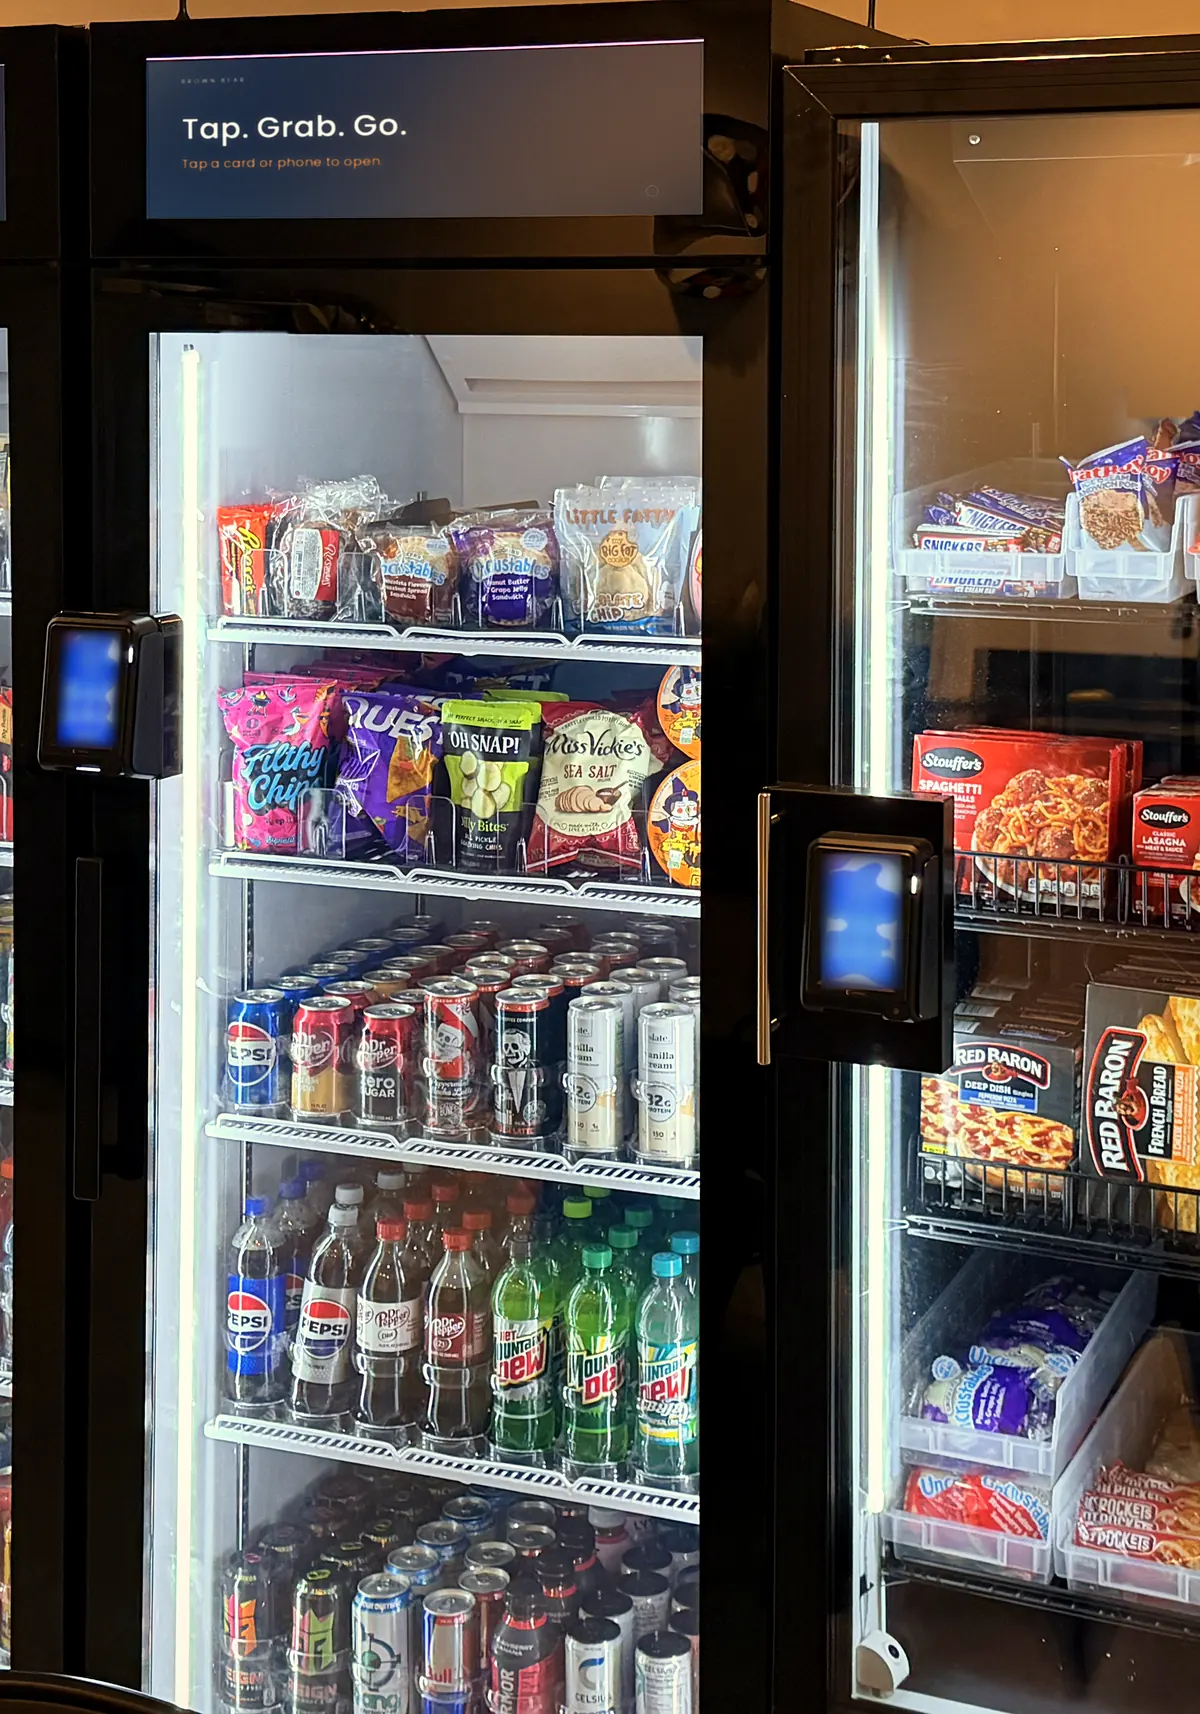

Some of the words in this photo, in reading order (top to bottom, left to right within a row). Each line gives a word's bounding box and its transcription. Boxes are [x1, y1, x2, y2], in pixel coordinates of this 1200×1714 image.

[182, 117, 248, 147] Tap.
[257, 114, 345, 138] Grab.
[353, 113, 407, 136] Go.
[182, 158, 208, 171] Tap
[211, 160, 219, 169] a
[224, 158, 255, 169] card
[259, 159, 273, 168] or
[277, 157, 322, 170] phone
[326, 157, 340, 167] to
[344, 156, 381, 169] open
[341, 696, 444, 745] QUES
[450, 731, 469, 749] OH
[470, 733, 520, 754] SNAP!
[545, 733, 588, 755] Miss
[584, 729, 644, 761] Vickie's
[240, 741, 325, 777] Filthy
[922, 752, 983, 772] Stouffer's
[564, 764, 582, 779] SEA
[588, 764, 618, 779] SALT
[919, 779, 983, 795] SPAGHETTI
[1141, 808, 1189, 824] Stouffer's
[477, 819, 507, 832] Bites
[1142, 836, 1187, 847] LASAGNA
[230, 1046, 273, 1062] EPSI
[955, 1048, 986, 1067] RED
[987, 1046, 1042, 1079] BARON
[363, 1075, 396, 1089] ero
[964, 1080, 988, 1091] DEEP
[989, 1083, 1011, 1094] DISH
[1095, 1039, 1134, 1120] BARON
[1150, 1066, 1168, 1107] BREAD
[362, 1088, 395, 1098] UGAR
[1148, 1107, 1166, 1155] FRENCH
[1099, 1121, 1131, 1172] RED
[575, 1692, 612, 1704] CELSIU
